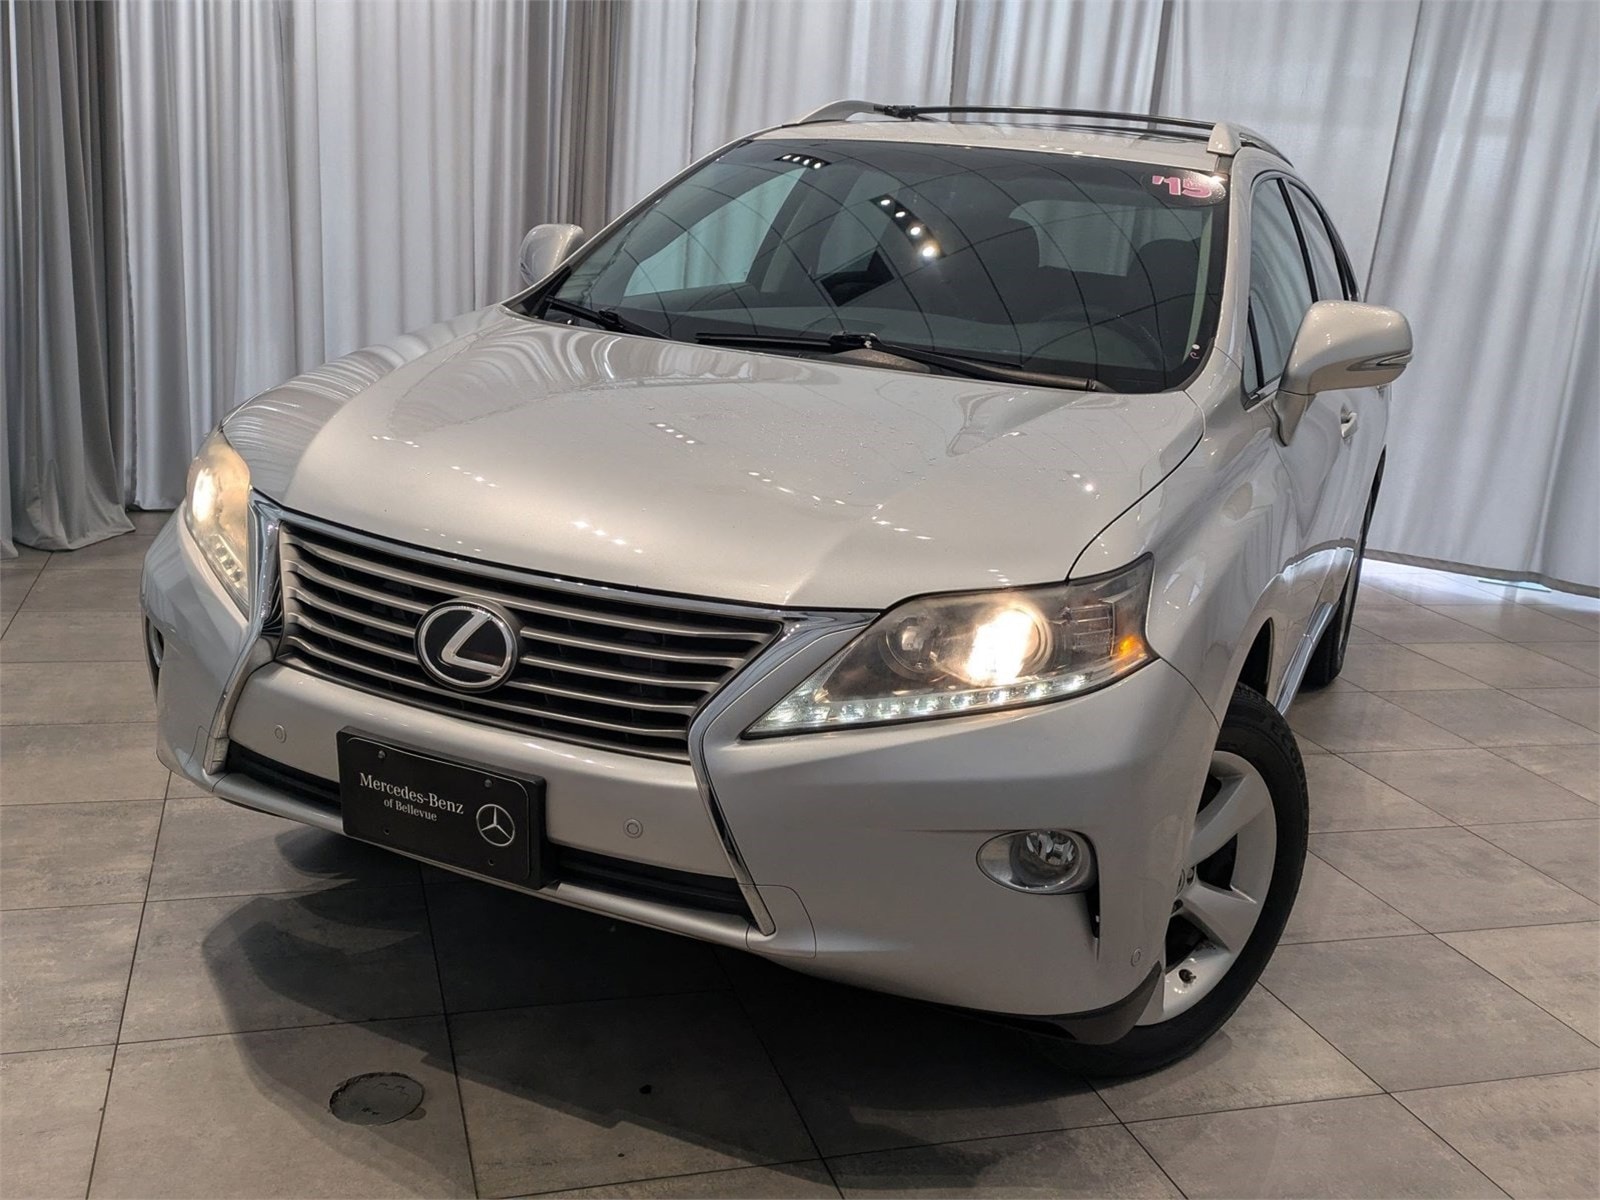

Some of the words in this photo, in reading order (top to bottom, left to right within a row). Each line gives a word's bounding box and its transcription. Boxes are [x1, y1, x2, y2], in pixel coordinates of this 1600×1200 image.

[359, 772, 464, 815] Mercedes-Benz
[383, 798, 394, 808] of
[395, 800, 438, 821] Bellevue
